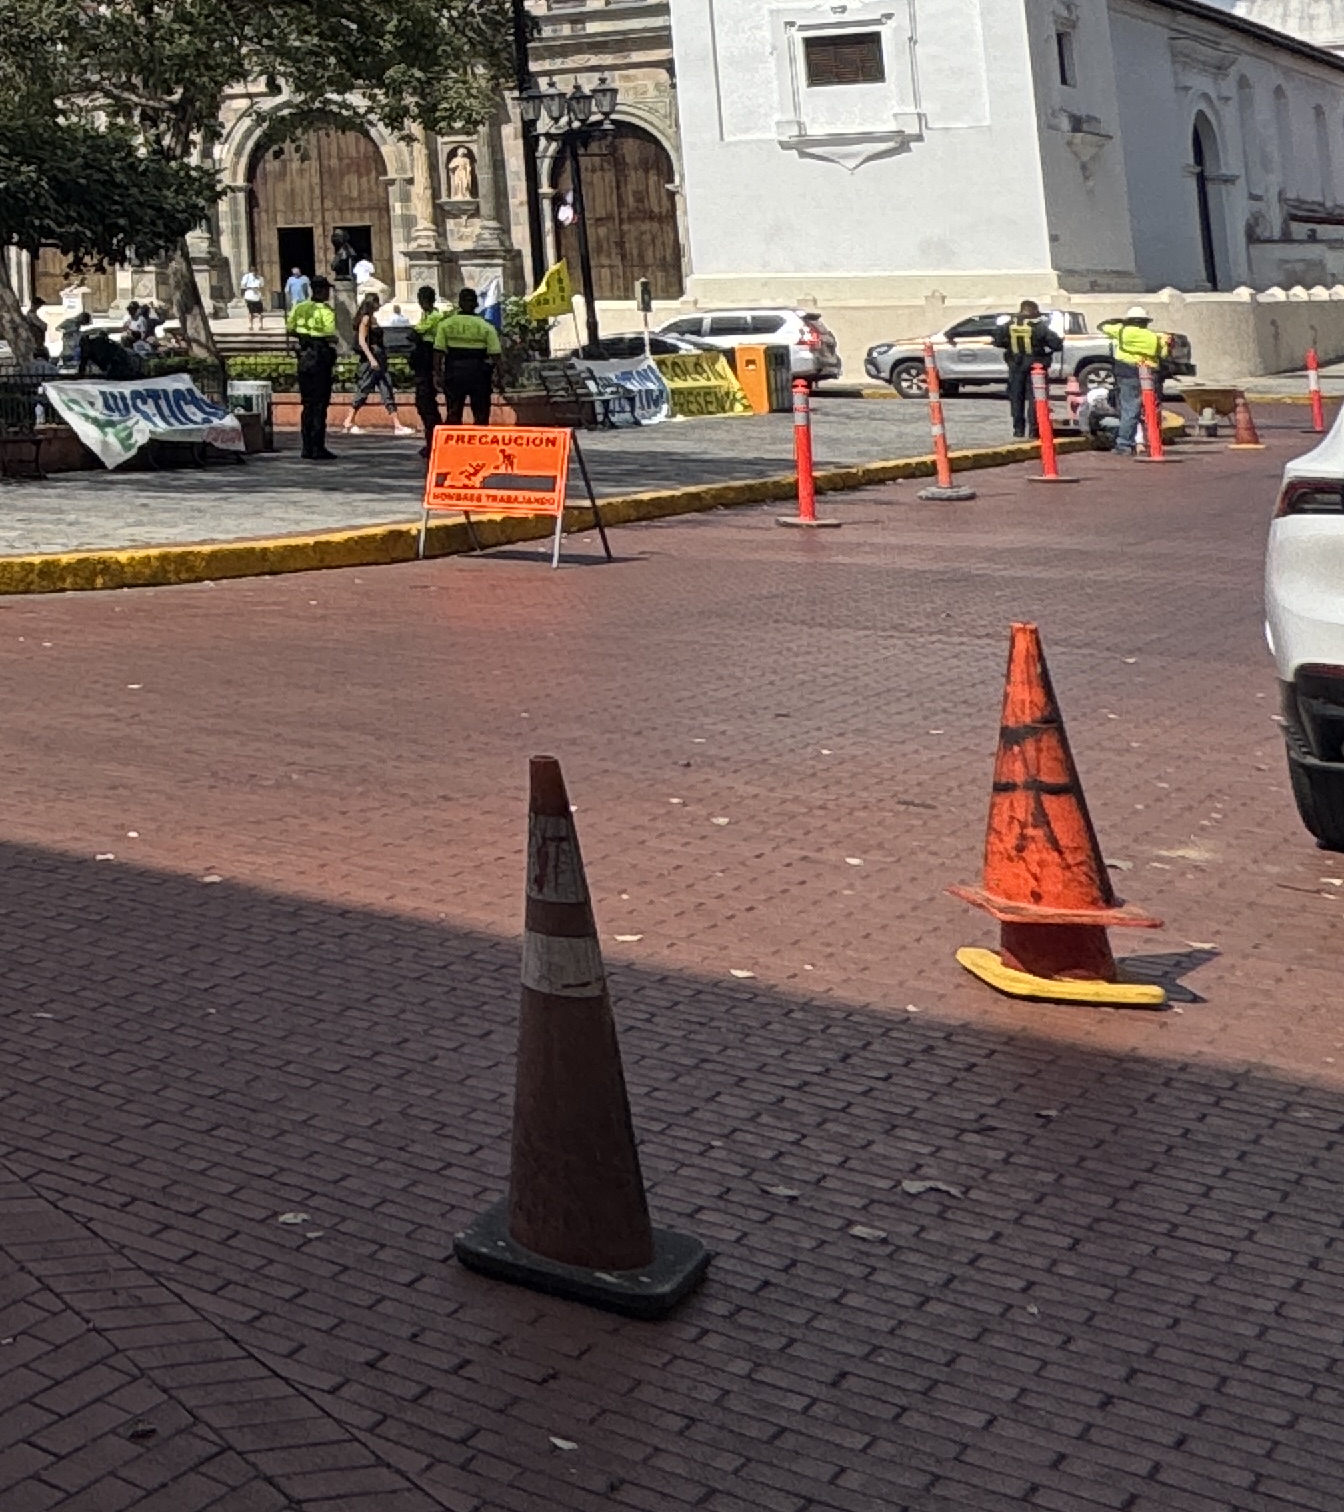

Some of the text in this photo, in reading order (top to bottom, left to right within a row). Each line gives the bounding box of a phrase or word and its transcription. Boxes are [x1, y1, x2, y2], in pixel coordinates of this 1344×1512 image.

[444, 433, 557, 448] PRECAUCIÓN
[433, 492, 555, 505] HOMBRES TRABAJANDO
